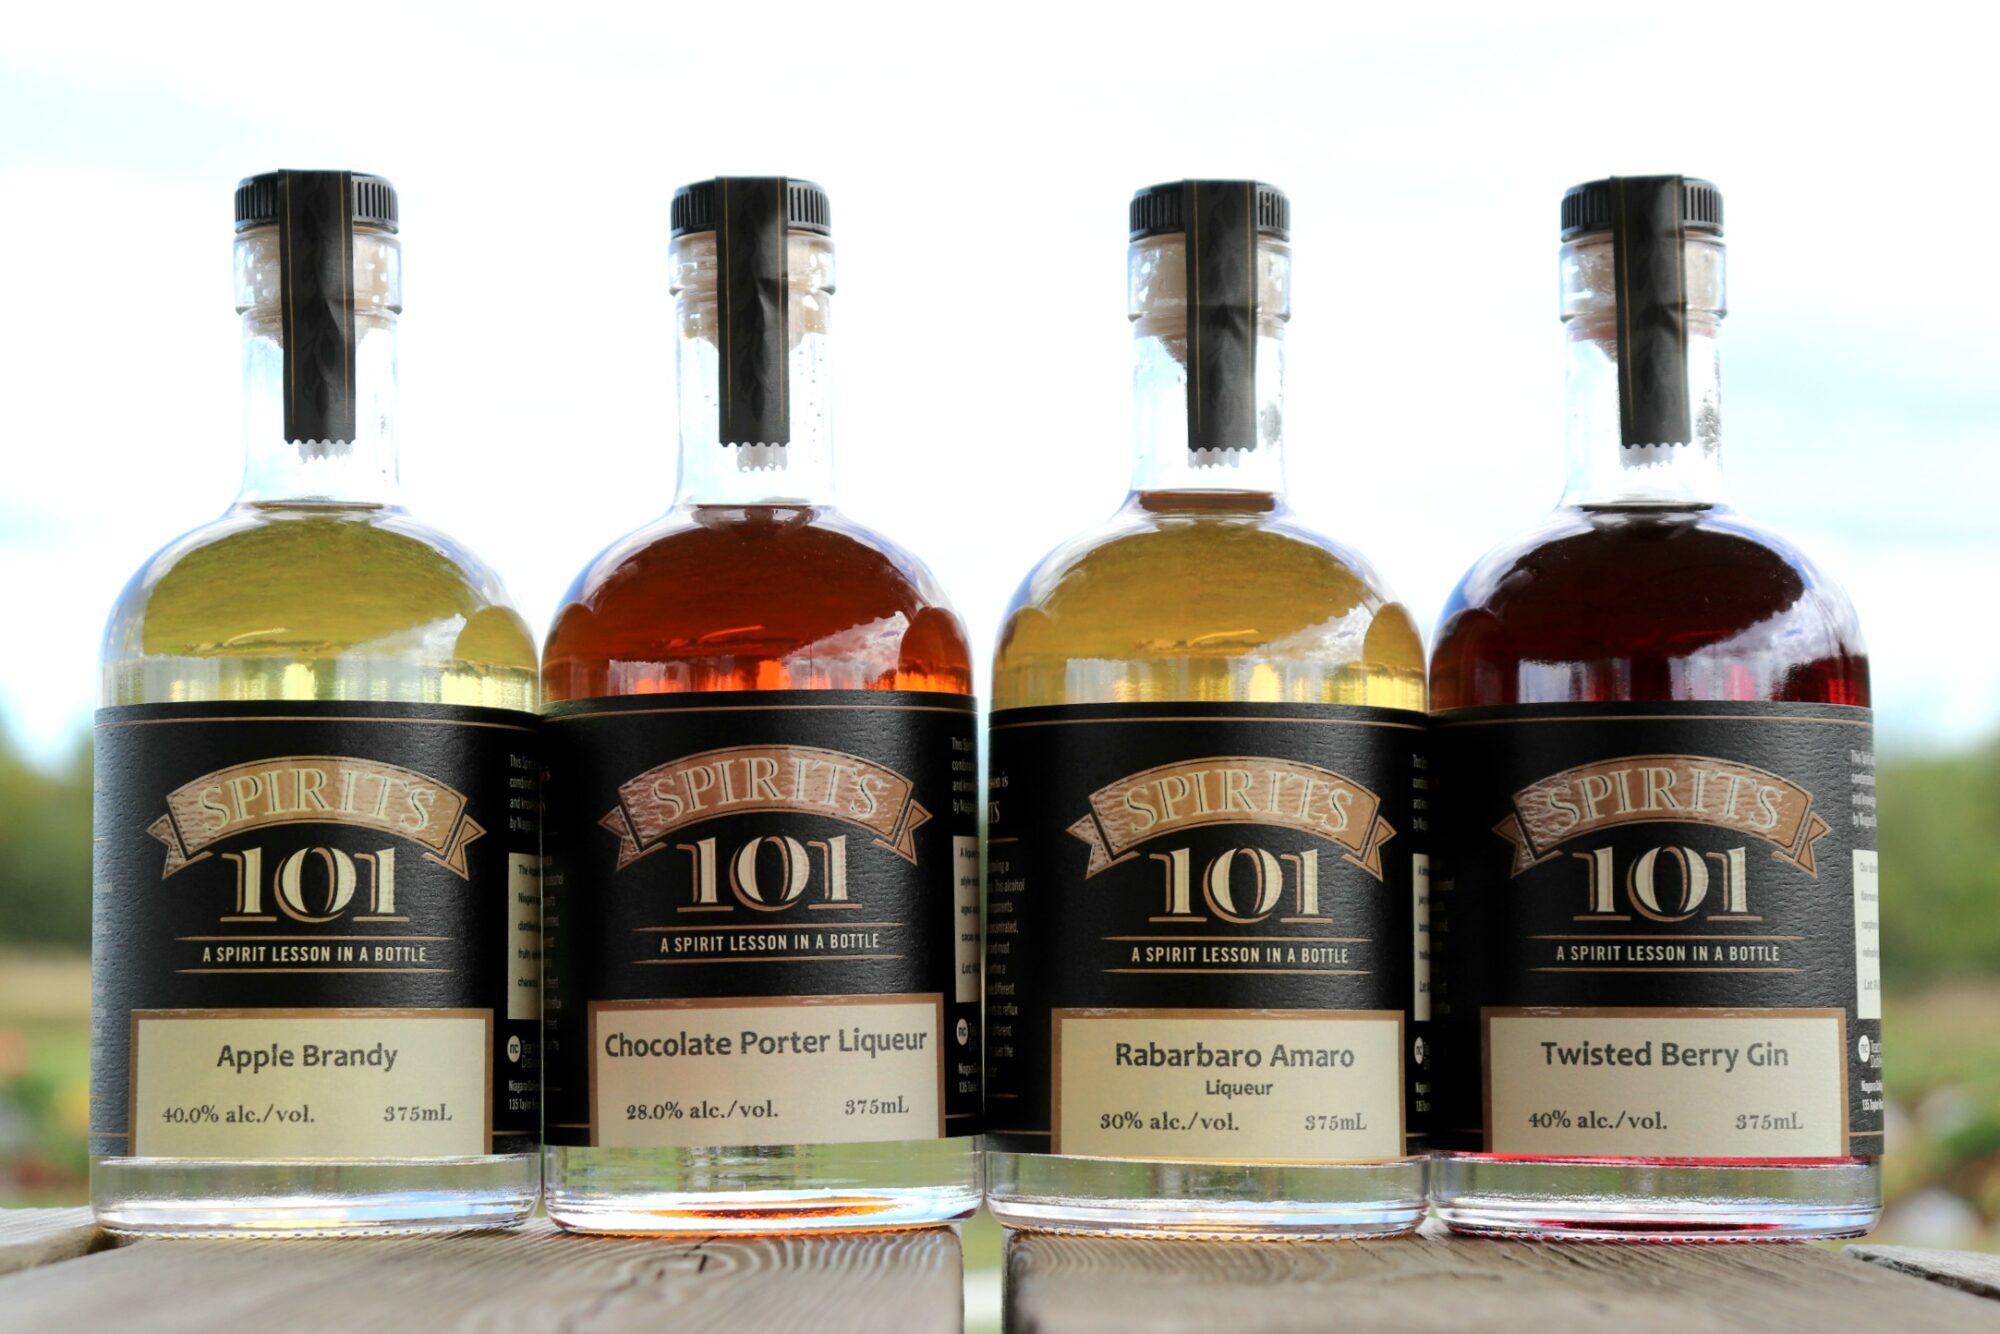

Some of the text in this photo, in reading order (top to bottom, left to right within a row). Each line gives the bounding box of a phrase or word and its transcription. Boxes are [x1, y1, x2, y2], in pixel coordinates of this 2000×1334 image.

[199, 767, 437, 832] SPIRITS
[652, 756, 886, 824] SPIRITS
[1125, 768, 1354, 832] SPIRITS
[1549, 766, 1785, 831] SPIRITS
[676, 834, 864, 912] 101
[220, 847, 411, 923] 101
[1148, 847, 1334, 924] 101
[1572, 846, 1764, 922] 101
[660, 933, 880, 952] A SPIRIT LESSON IN A BOTTLE
[203, 947, 427, 962] A SPIRIT LESSON IN A BOTTLE
[1132, 947, 1349, 964] A SPIRIT LESSON IN A BOTTLE
[1557, 946, 1780, 961] A SPIRIT LESSON IN A BOTTLE
[605, 1028, 928, 1058] Chocolate Porter Liqueur
[217, 1043, 398, 1074] Apple Brandy
[1115, 1042, 1354, 1067] Rabarbaro Amaro
[1541, 1040, 1789, 1072] Twisted Berry Gin
[1205, 1079, 1274, 1100] Liqueur
[162, 1104, 315, 1124] 40.0% alc./vol.
[384, 1104, 453, 1122] 375mL
[626, 1099, 779, 1120] 28.0% alc./vol.
[845, 1096, 910, 1115] 375mL
[1100, 1110, 1240, 1131] 30% alc./vol.
[1305, 1113, 1367, 1131] 375mL
[1528, 1110, 1668, 1130] 40% alc./vol.
[1735, 1112, 1804, 1130] 375mL
